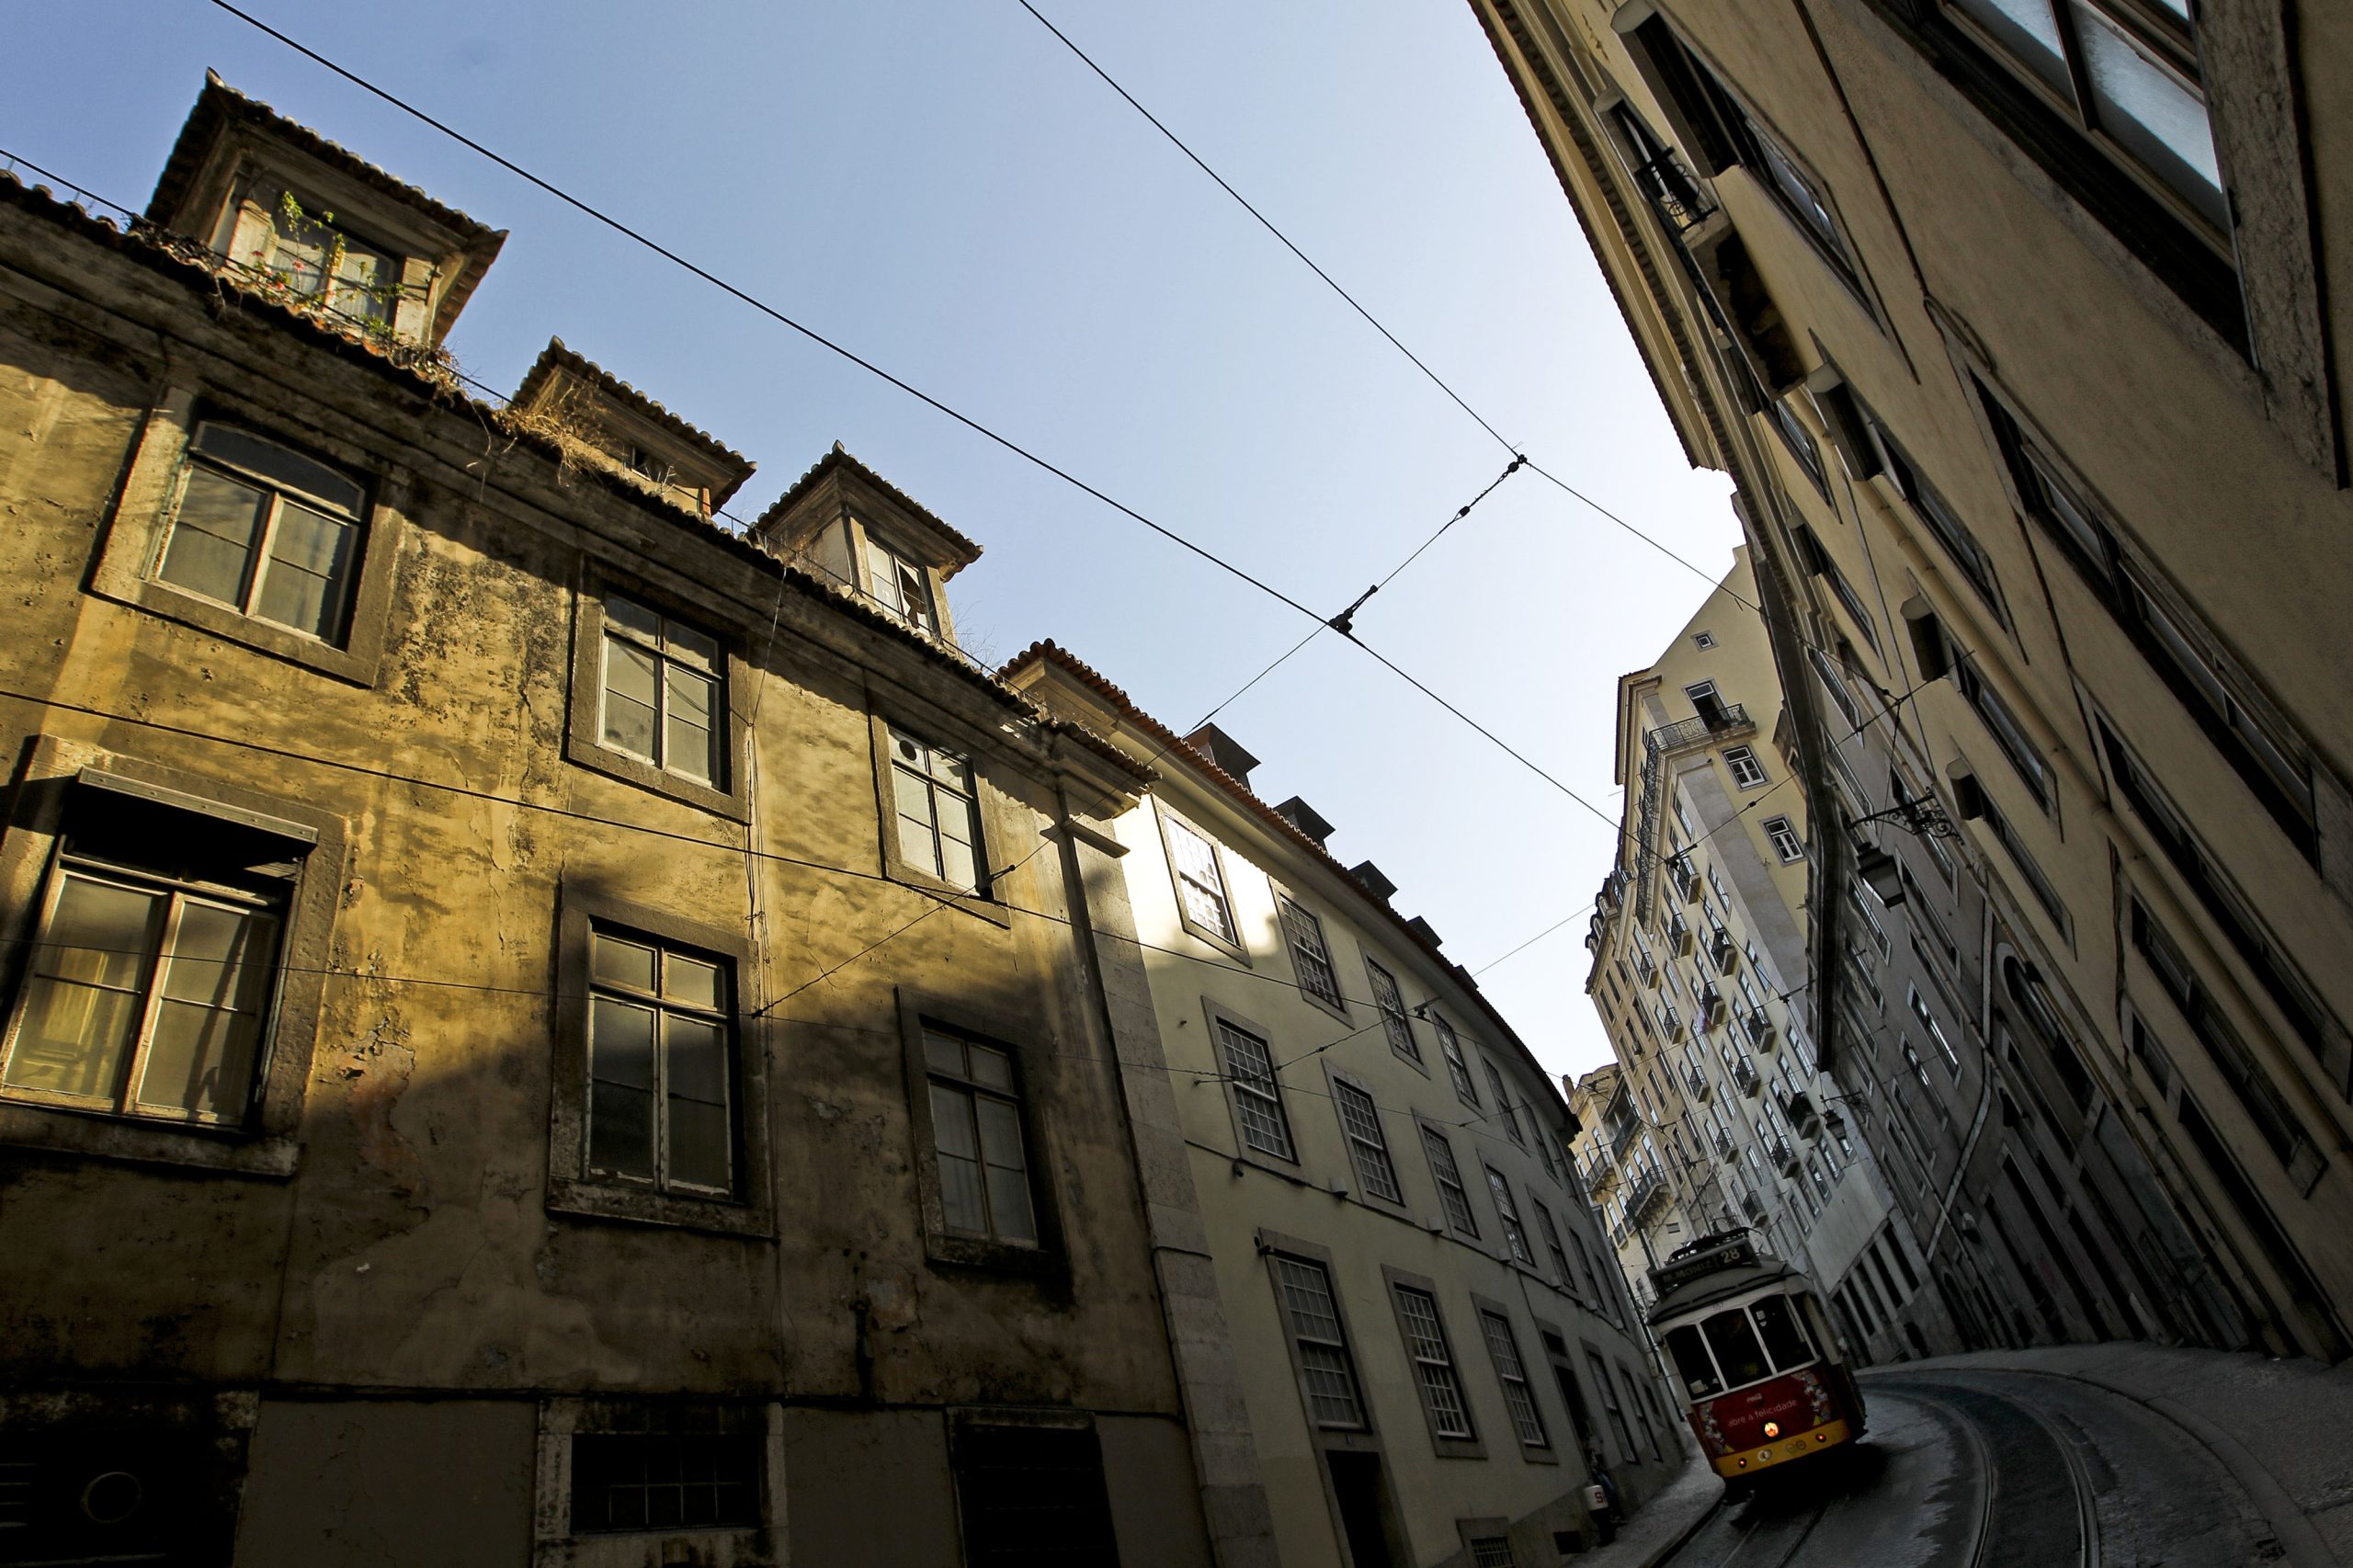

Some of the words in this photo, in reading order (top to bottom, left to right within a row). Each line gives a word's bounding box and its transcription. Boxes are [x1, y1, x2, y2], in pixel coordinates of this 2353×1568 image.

[1721, 1248, 1740, 1264] 28
[1728, 1415, 1746, 1427] abre
[1754, 1399, 1799, 1418] felicidade
